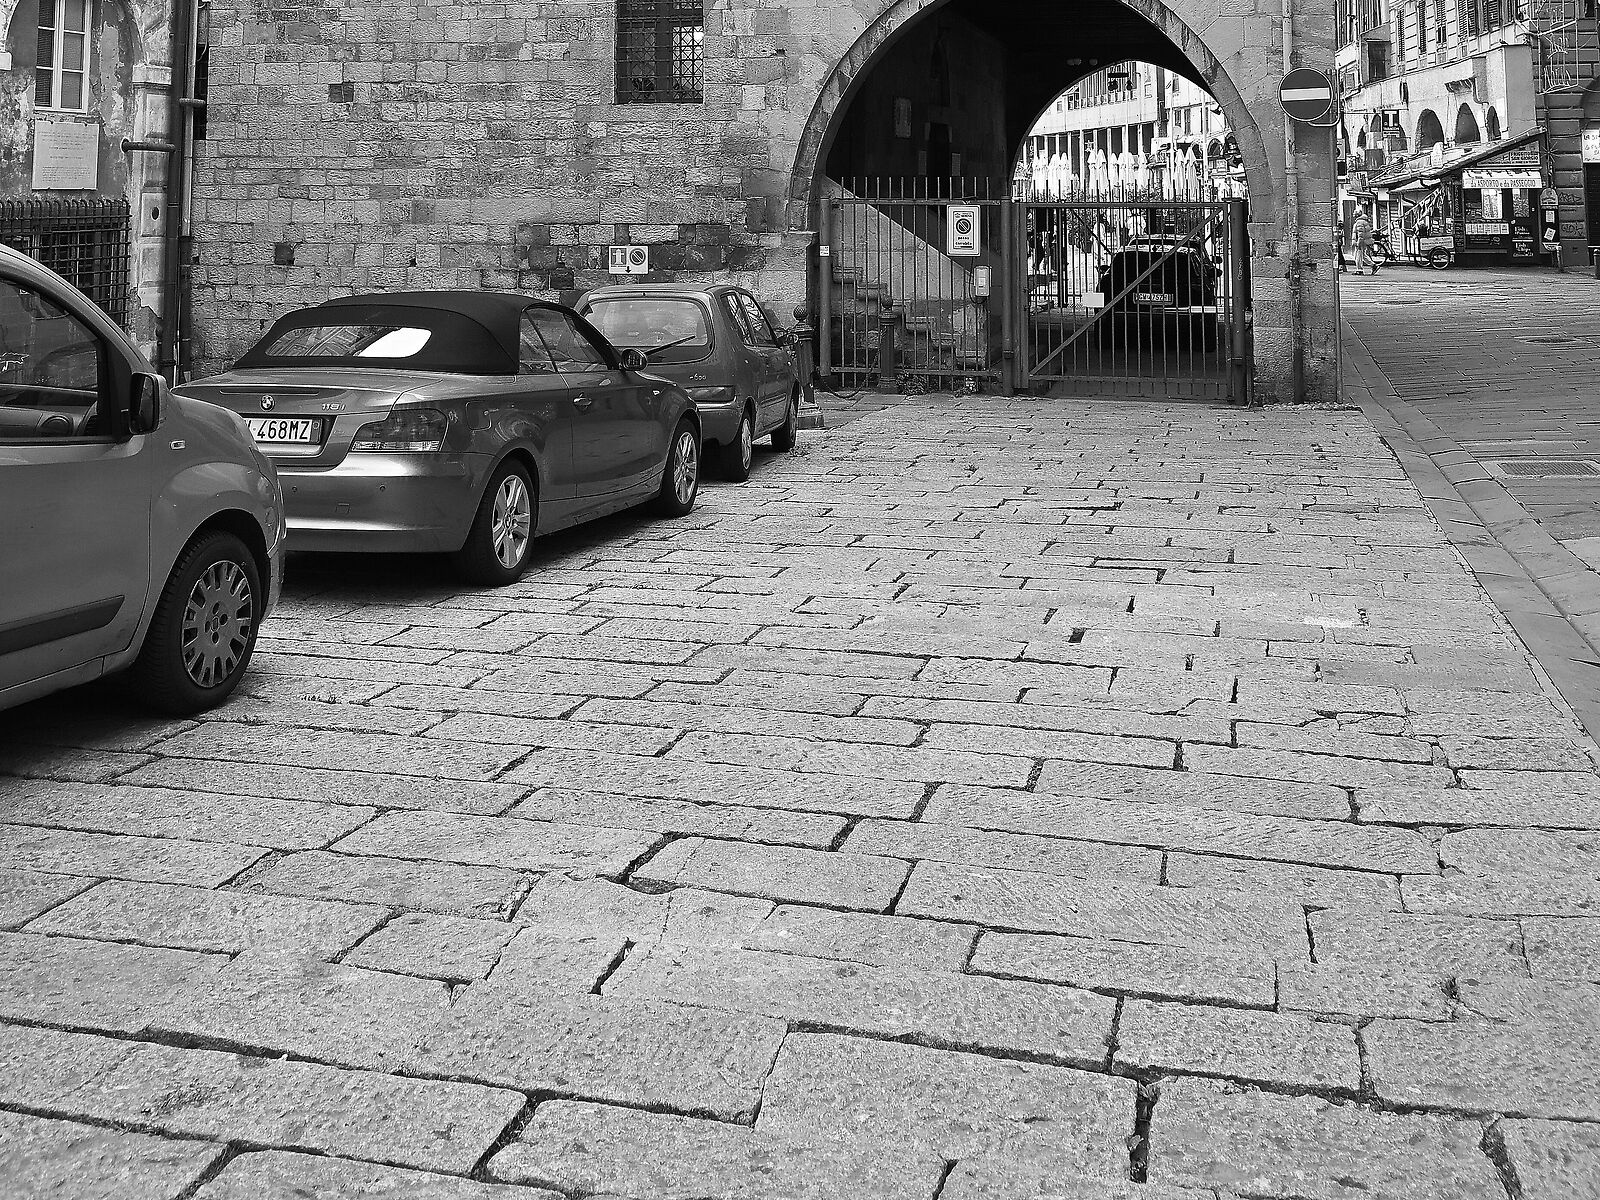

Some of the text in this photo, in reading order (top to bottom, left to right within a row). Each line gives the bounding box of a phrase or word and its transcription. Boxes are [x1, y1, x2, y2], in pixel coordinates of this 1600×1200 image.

[1384, 111, 1397, 127] T
[1477, 179, 1499, 188] ASPORTO
[1510, 179, 1536, 188] PASSEGGIO
